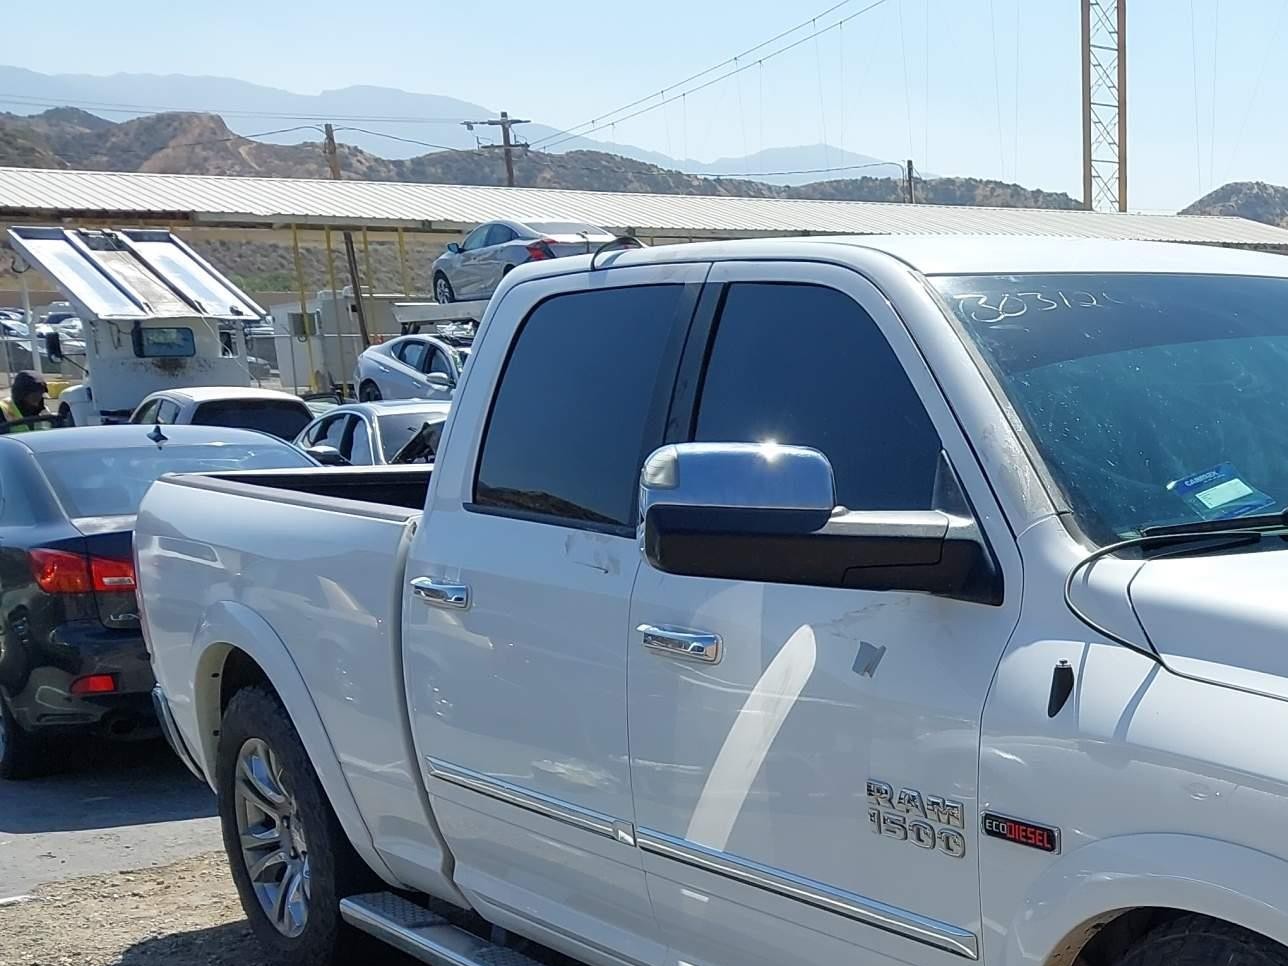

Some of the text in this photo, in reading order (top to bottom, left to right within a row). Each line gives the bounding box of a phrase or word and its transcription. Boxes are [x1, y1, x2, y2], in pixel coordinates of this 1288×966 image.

[866, 778, 965, 830] RAM
[868, 807, 966, 859] 1500
[985, 818, 1052, 849] ECODIESEL
